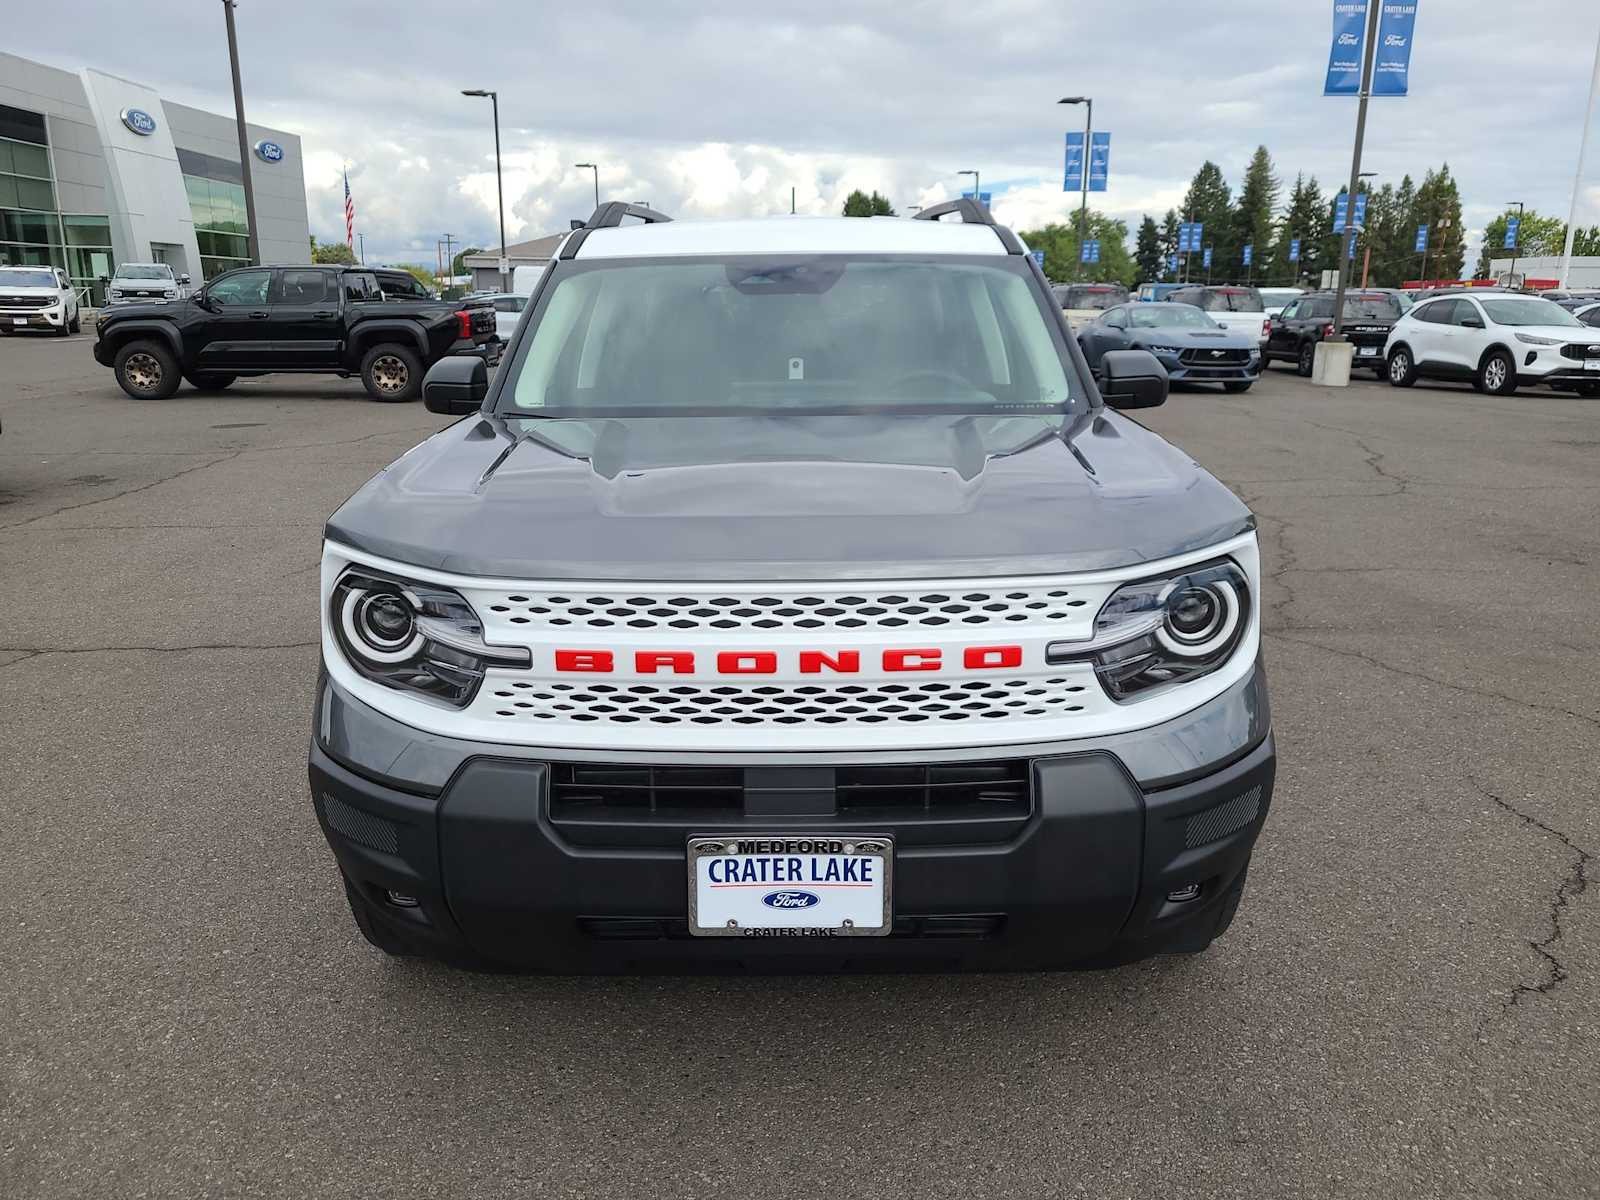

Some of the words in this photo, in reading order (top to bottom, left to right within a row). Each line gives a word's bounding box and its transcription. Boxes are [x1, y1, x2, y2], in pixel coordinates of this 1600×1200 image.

[1338, 33, 1358, 45] Ford
[1384, 35, 1406, 46] Ford
[555, 645, 1022, 674] BRONCO
[737, 840, 843, 854] MEDFORD
[708, 858, 803, 883] CRATER
[811, 858, 873, 882] LAKE
[772, 891, 809, 908] Ford
[743, 927, 799, 936] CRATER
[801, 927, 838, 936] LAKE
